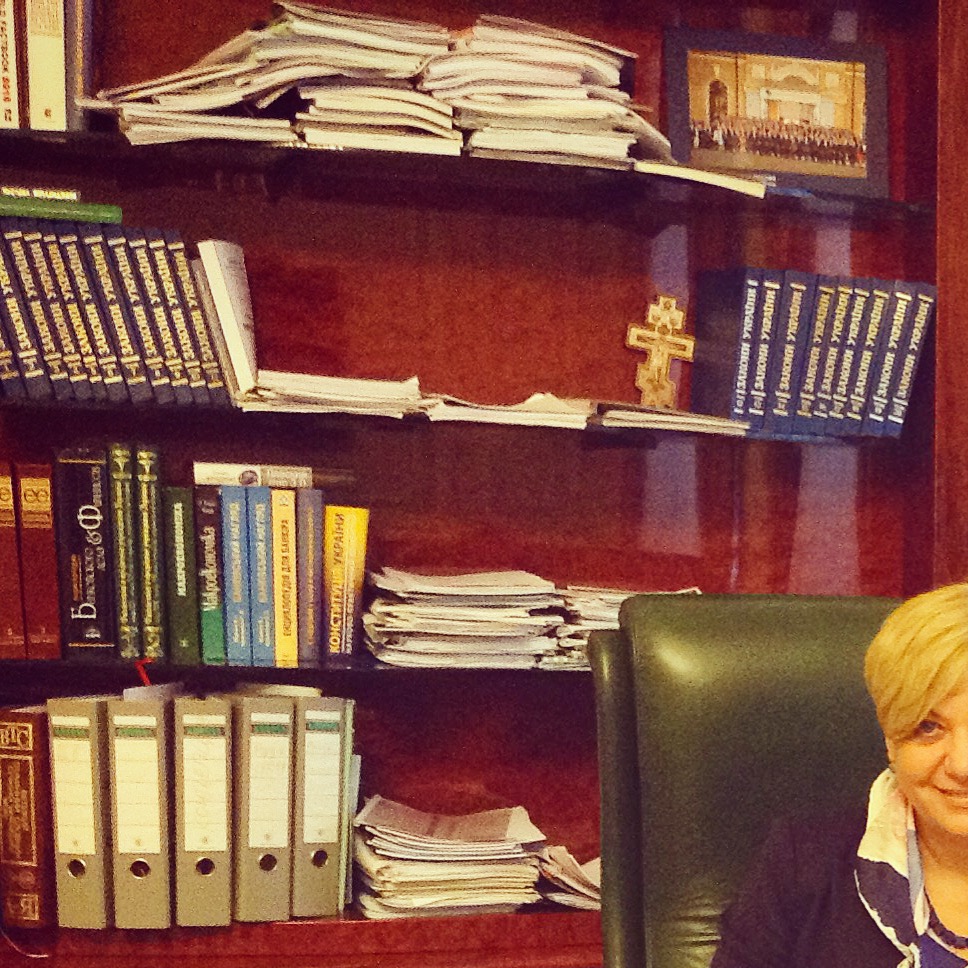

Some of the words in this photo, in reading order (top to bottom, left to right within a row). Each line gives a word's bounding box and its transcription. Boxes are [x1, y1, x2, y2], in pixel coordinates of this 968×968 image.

[743, 288, 757, 340] УКРАЇНИ
[761, 289, 776, 340] УКРАЇНИ
[787, 291, 803, 342] УКРАЇНИ
[737, 342, 750, 390] ЗАКОНИ
[754, 344, 769, 390] ЗАКОНИ
[780, 344, 795, 391] ЗАКОНИ
[804, 346, 820, 393] ЗАКОНИ
[813, 293, 831, 343] УКРАЇНИ
[821, 347, 838, 392] ЗАКОНИ
[831, 293, 850, 343] УКРАЇНИ
[837, 349, 854, 395] ЗАКОНИ
[847, 296, 866, 346] УКРАЇНИ
[855, 350, 873, 396] ЗАКОНИ
[865, 298, 885, 347] УКРАЇНИ
[876, 352, 895, 397] ЗАКОНИ
[888, 299, 908, 350] УКРАЇНИ
[897, 354, 916, 399] ЗАКОНИ
[909, 301, 930, 352] УКРАЇНИ
[333, 513, 345, 566] УКРАЇНИ
